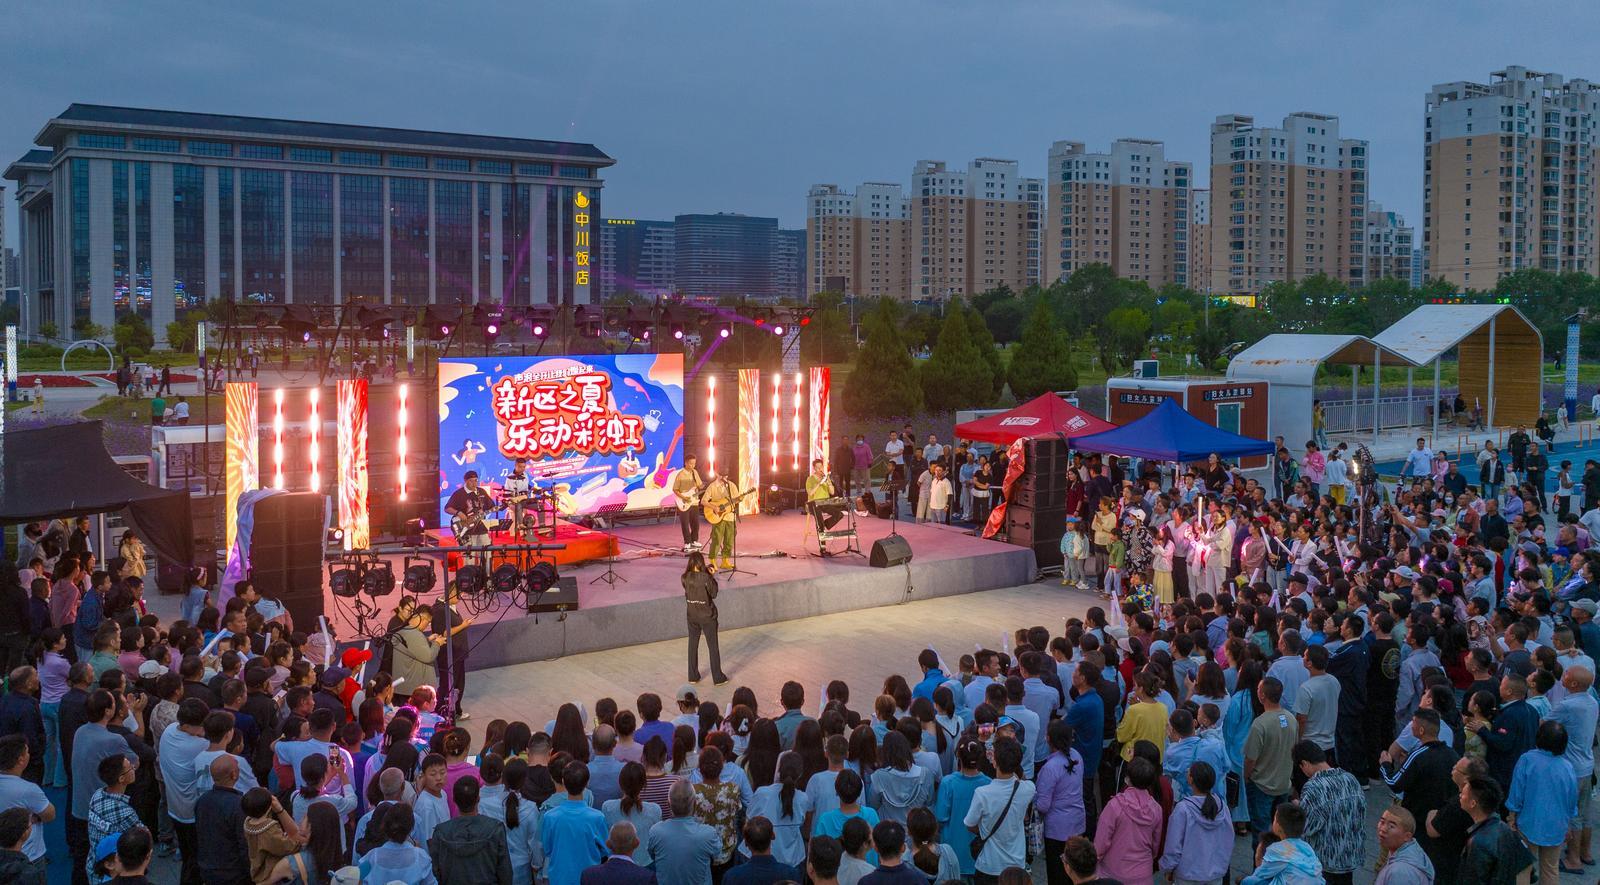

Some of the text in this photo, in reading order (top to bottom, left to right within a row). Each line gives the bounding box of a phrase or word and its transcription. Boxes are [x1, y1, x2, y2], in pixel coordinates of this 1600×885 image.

[575, 212, 589, 285] 中川饭店
[496, 375, 606, 419] 新区之夏
[1127, 394, 1168, 403] 妇女儿童驿
[503, 412, 641, 451] 乐动彩虹
